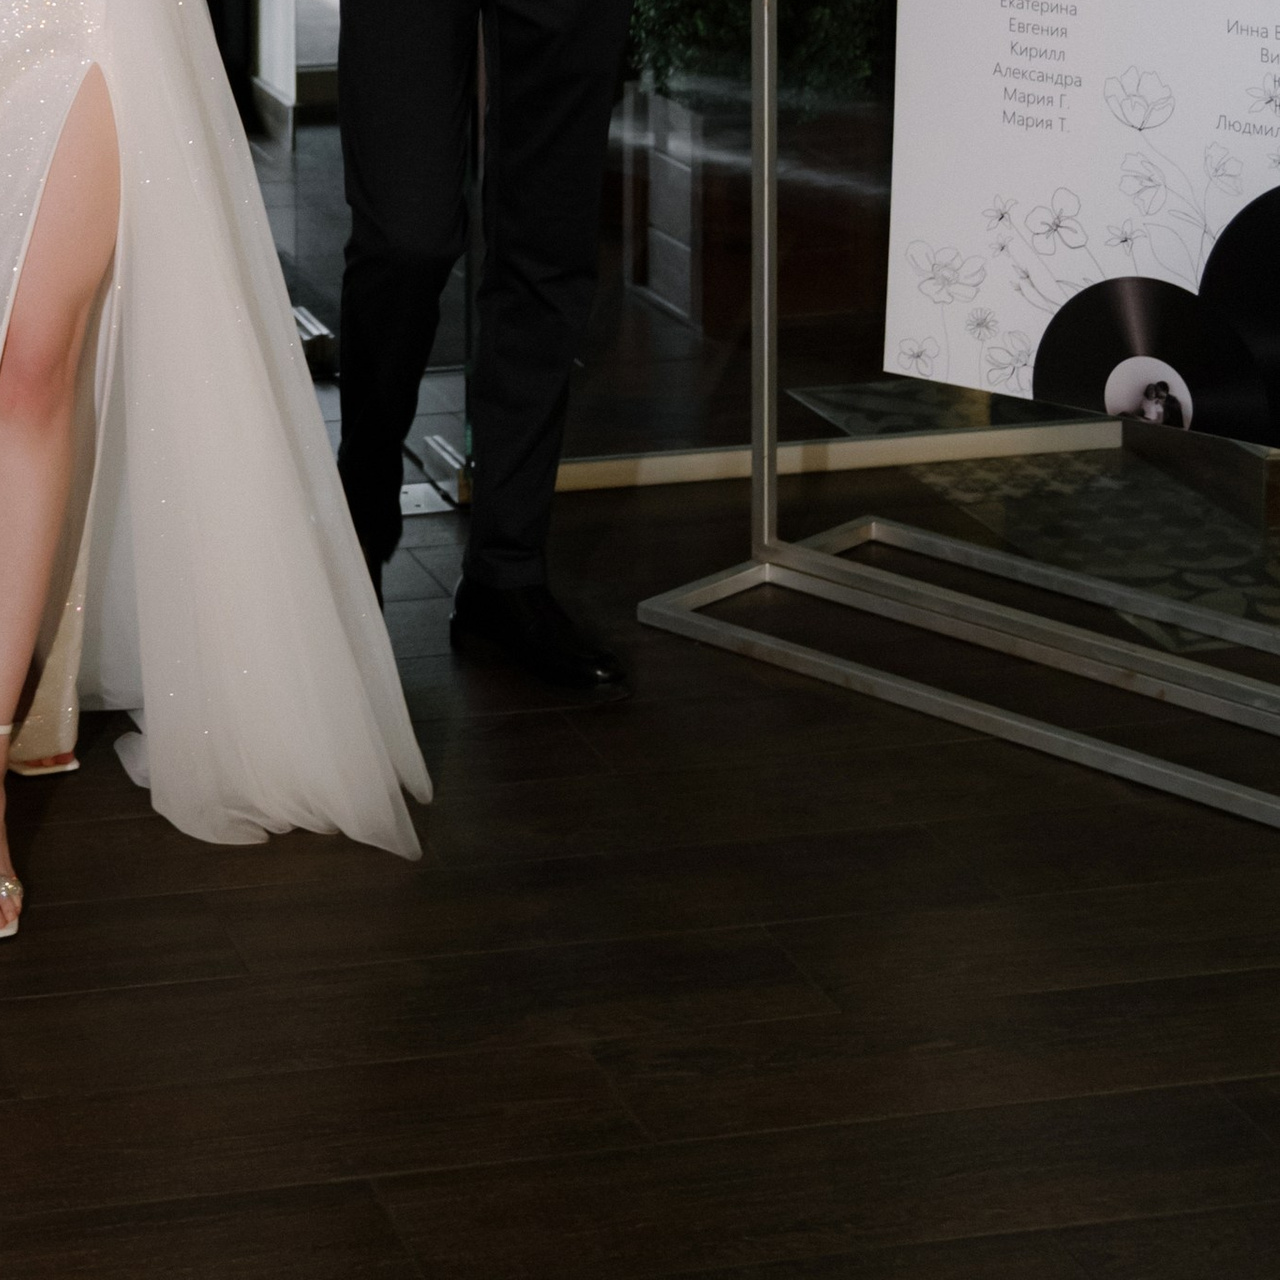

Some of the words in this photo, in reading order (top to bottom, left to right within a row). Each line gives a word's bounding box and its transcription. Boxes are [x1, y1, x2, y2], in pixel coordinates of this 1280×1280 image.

[1008, 17, 1067, 38] Евгения
[1227, 18, 1268, 39] Инна
[1010, 40, 1065, 61] Кирилл
[993, 61, 1082, 88] Александра
[1003, 86, 1054, 107] Мария
[1059, 93, 1070, 110] Г.
[1002, 110, 1053, 131] Мария
[1059, 117, 1071, 133] Т.
